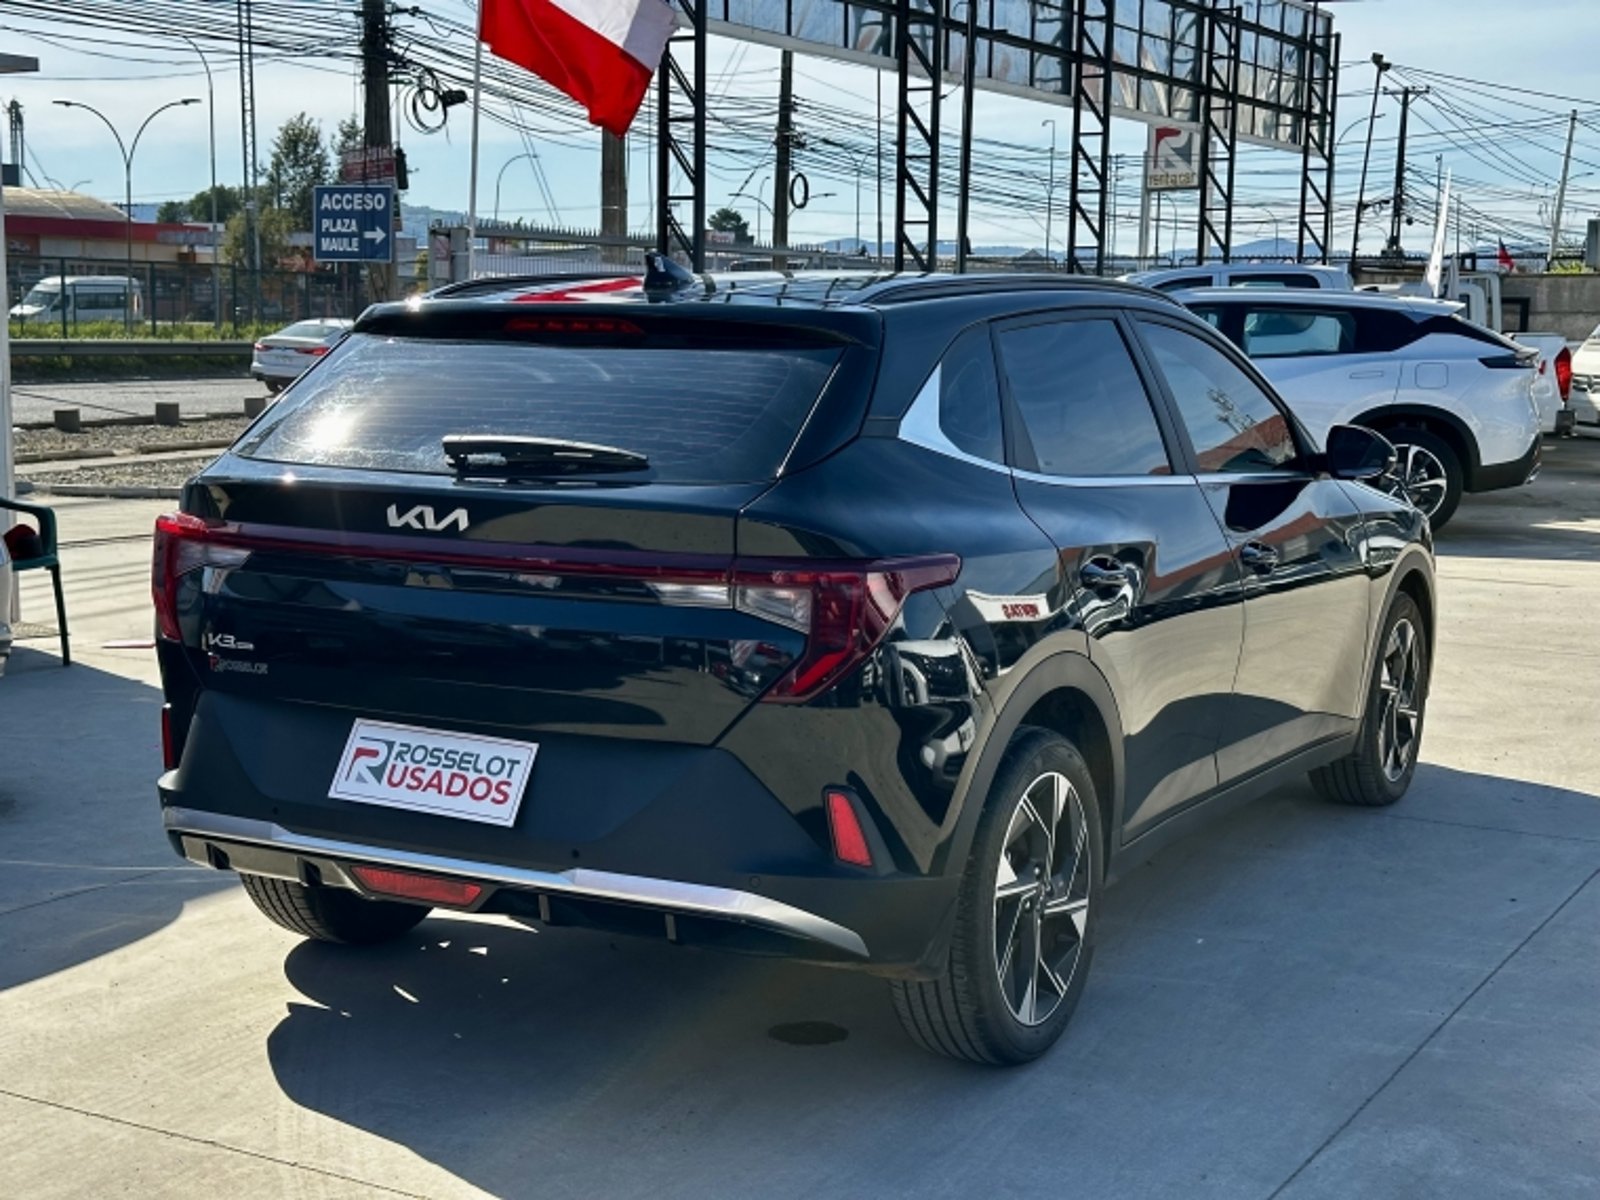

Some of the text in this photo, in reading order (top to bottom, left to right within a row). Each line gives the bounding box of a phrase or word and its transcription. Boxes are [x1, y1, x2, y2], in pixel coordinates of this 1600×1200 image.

[321, 193, 386, 210] ACCESO
[321, 218, 358, 232] PLAZA
[321, 237, 359, 251] MAULE
[387, 504, 469, 531] KIA
[208, 633, 236, 649] K3
[394, 743, 520, 778] ROSSELOT
[386, 764, 512, 805] USADOS
